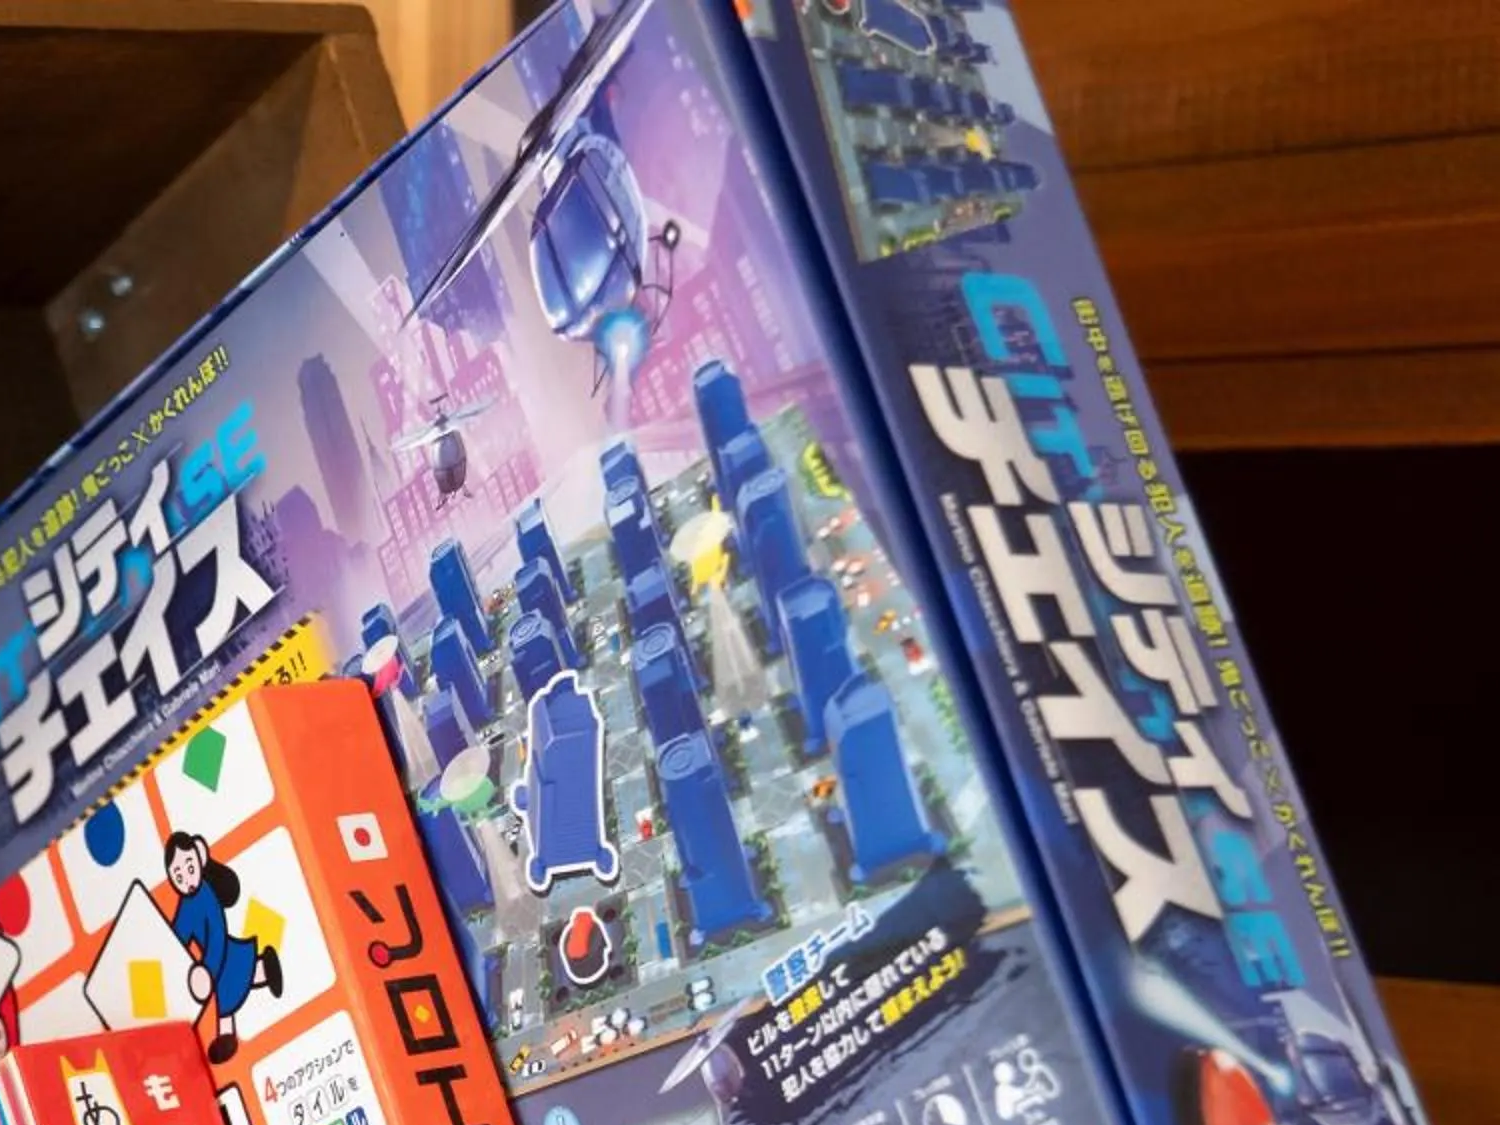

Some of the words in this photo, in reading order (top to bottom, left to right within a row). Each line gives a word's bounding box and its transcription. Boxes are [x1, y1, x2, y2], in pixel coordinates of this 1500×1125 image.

[909, 364, 1224, 944] チェイス
[259, 1038, 356, 1105] 4つのアクションで
